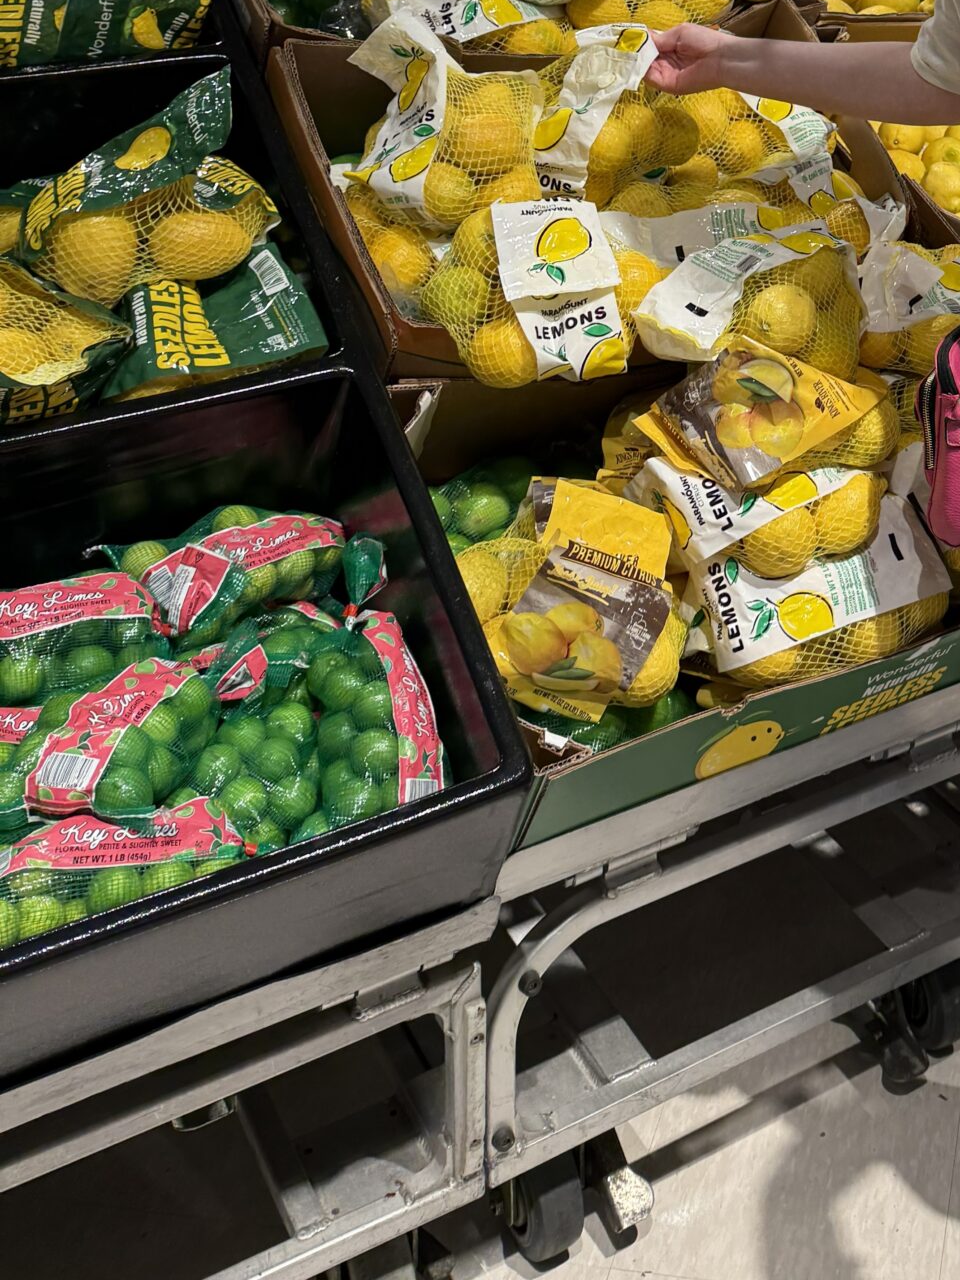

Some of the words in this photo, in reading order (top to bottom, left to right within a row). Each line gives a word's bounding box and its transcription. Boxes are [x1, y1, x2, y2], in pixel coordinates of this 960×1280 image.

[539, 173, 577, 194] ONS
[131, 290, 148, 346] Naturally
[150, 280, 191, 370] SEEDLES
[181, 284, 231, 367] LEMON
[534, 306, 607, 340] LEMONS
[701, 477, 734, 531] LEMO
[251, 530, 299, 552] Limes
[569, 545, 621, 572] PREMIUM
[621, 563, 657, 586] CITRUS
[828, 584, 837, 596] WT
[831, 596, 839, 607] NET
[0, 596, 38, 619] Key
[44, 591, 104, 607] Limes
[708, 562, 744, 653] LEMONS
[867, 643, 957, 686] Wonderful
[862, 662, 938, 698] Naturally
[827, 666, 948, 725] SEEDLESS
[3, 712, 35, 731] Ke
[415, 700, 430, 737] Key
[60, 822, 108, 848] Key
[99, 841, 120, 851] PETITE
[122, 841, 127, 849] &
[129, 840, 158, 849] SLIGHTLY
[160, 839, 181, 848] SWEET
[73, 856, 90, 864] NET
[91, 855, 107, 863] WT.
[115, 854, 125, 862] LB
[127, 853, 151, 862] (454g)
